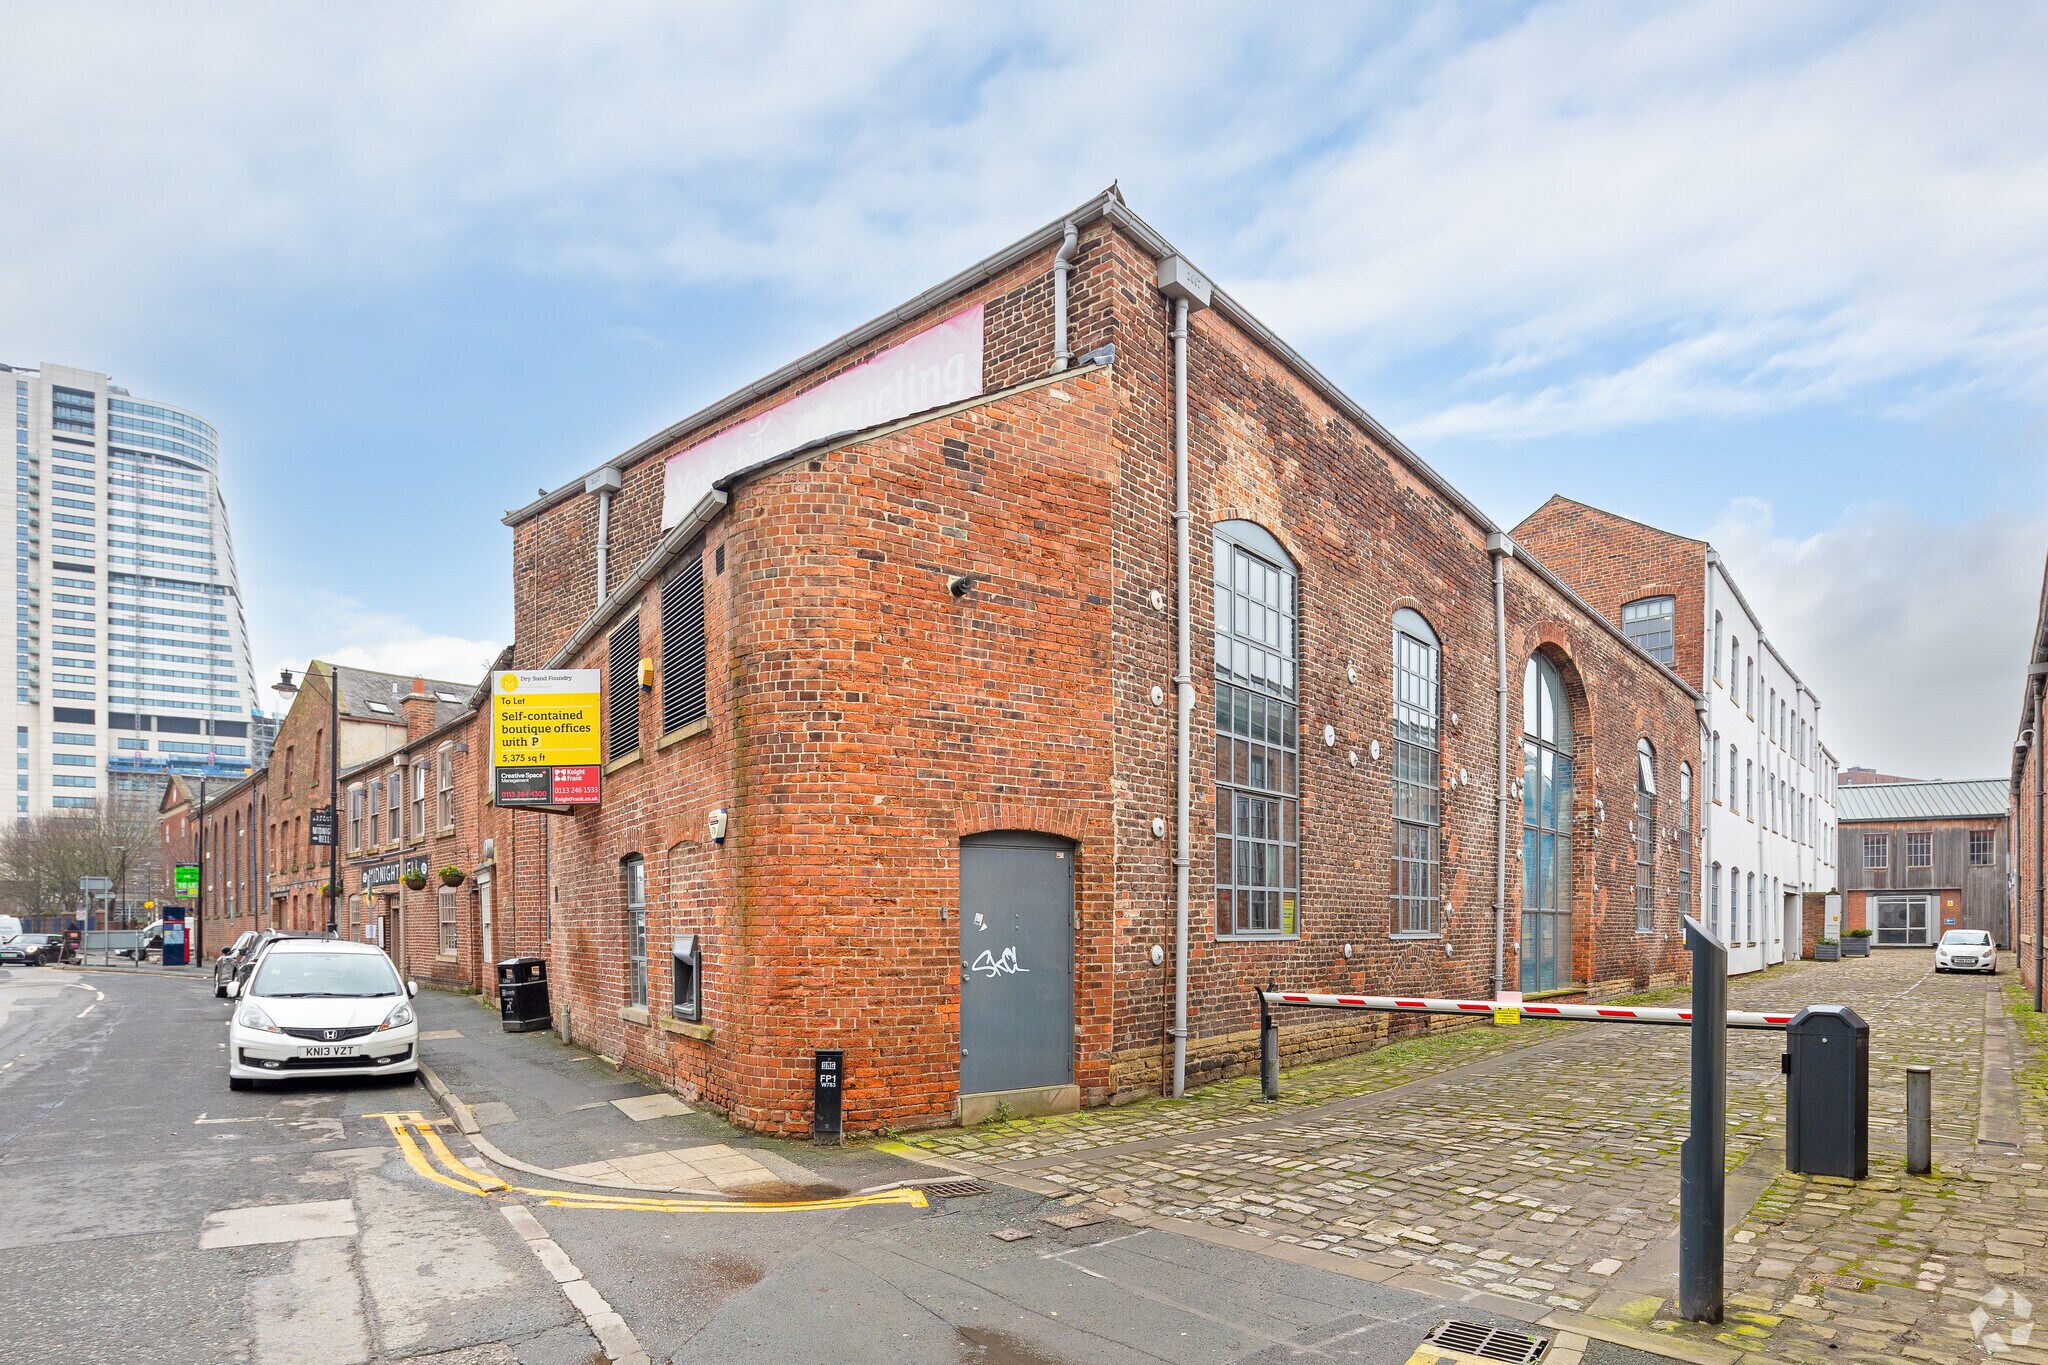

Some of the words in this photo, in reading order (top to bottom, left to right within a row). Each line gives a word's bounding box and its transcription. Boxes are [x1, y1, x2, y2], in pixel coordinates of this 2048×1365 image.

[501, 697, 511, 705] To
[513, 697, 526, 705] Let
[501, 710, 584, 721] Self-contained
[501, 724, 551, 736] boutique
[554, 723, 591, 733] offices
[501, 737, 528, 747] with
[502, 753, 526, 763] 5,375
[527, 755, 538, 764] sq
[539, 753, 546, 762] ft
[571, 786, 583, 794] 246
[368, 864, 400, 883] MIDNIGHT
[306, 1047, 331, 1056] KN13
[333, 1046, 354, 1055] VZT
[820, 1074, 837, 1083] FP1
